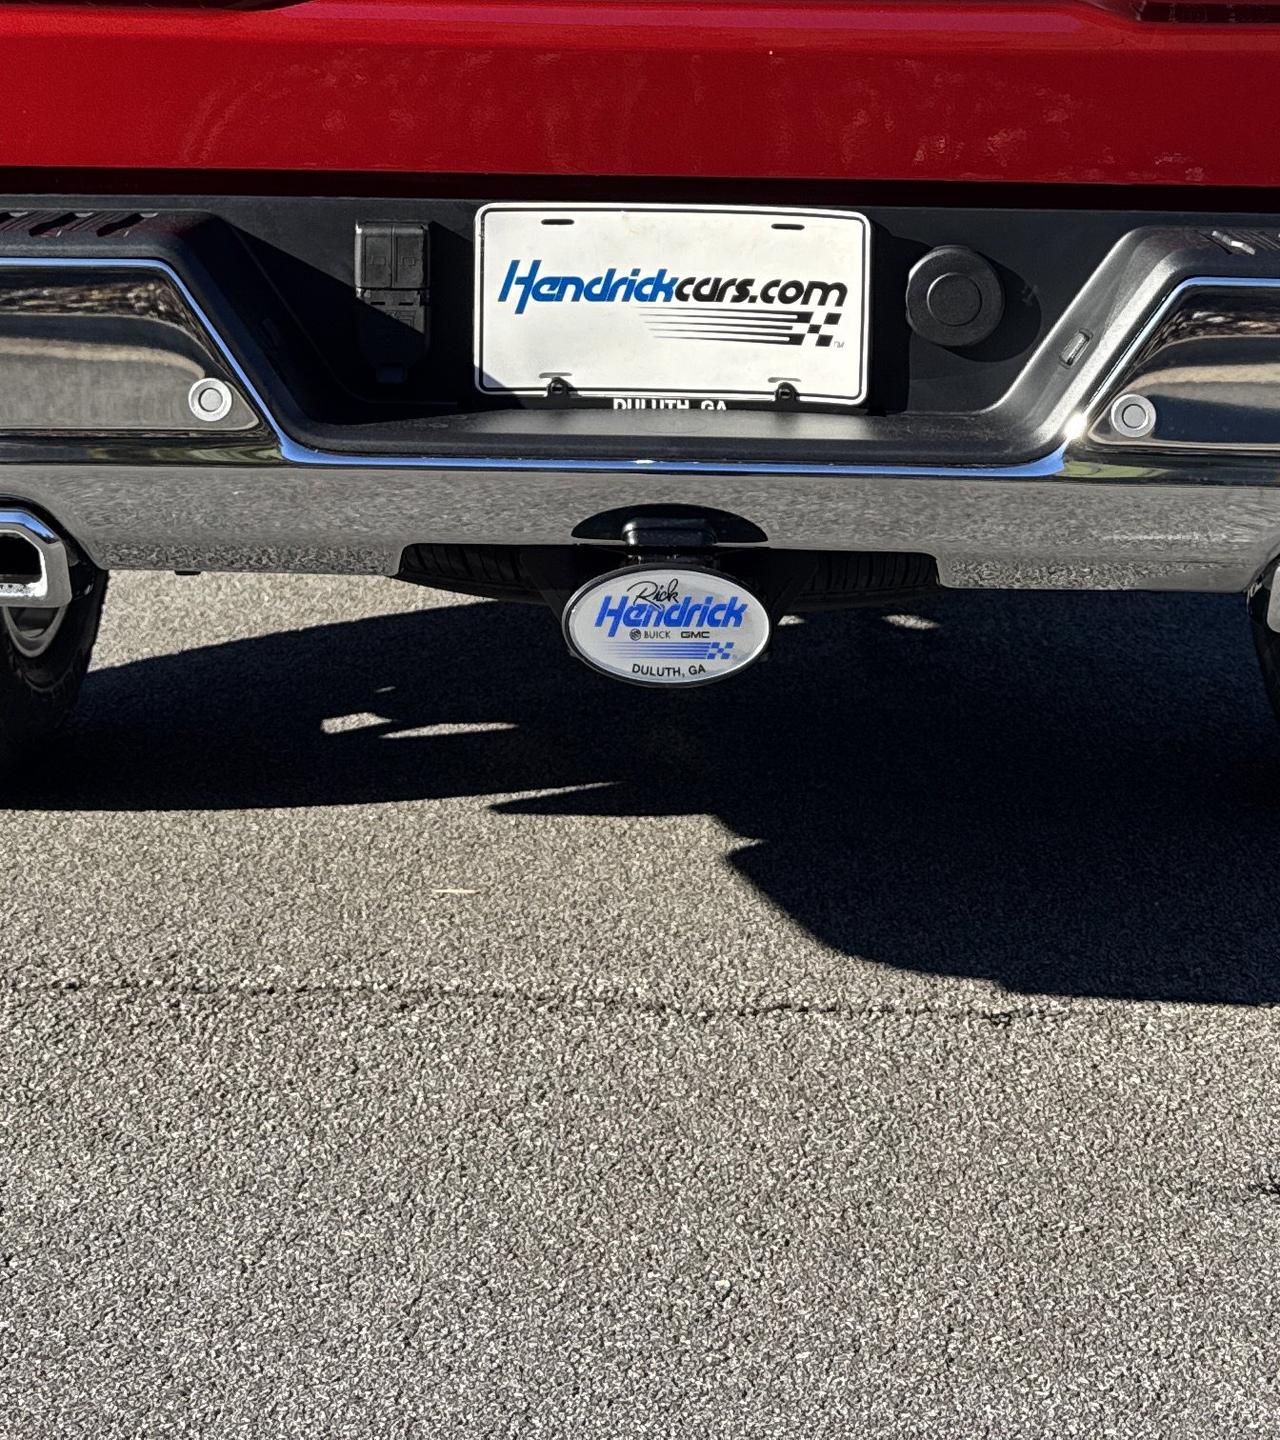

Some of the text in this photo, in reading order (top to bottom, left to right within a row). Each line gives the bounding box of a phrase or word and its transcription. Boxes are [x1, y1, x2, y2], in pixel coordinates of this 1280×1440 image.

[497, 259, 849, 315] Hendrickcars.com
[626, 578, 680, 612] Rick
[594, 594, 749, 639] Hendrick
[643, 630, 711, 640] BUICK GMC
[632, 663, 707, 678] DULUTH, GA
